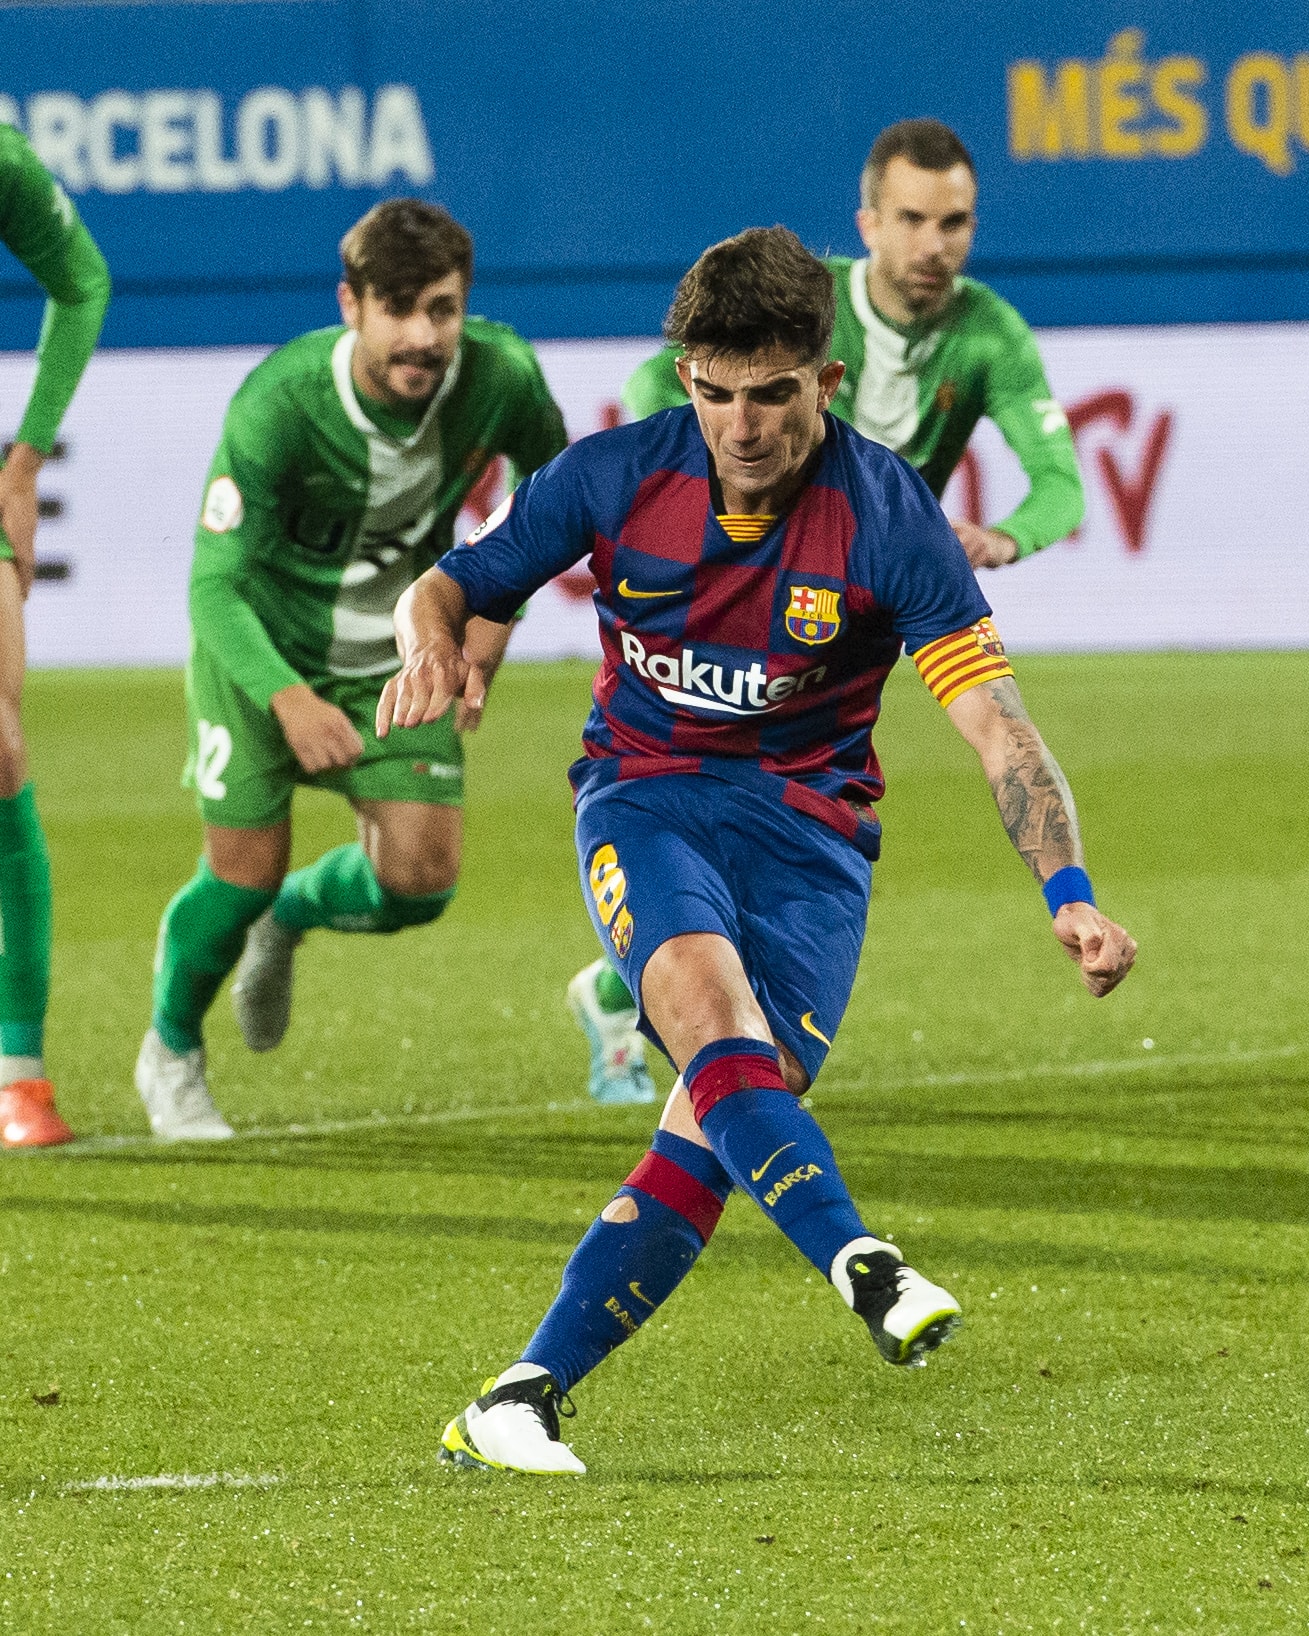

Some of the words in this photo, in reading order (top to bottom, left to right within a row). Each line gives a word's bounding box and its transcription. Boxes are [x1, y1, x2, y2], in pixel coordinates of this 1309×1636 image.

[1008, 26, 1207, 160] MÉS
[0, 84, 436, 193] RCELONA
[620, 630, 828, 707] Rakuten
[589, 843, 627, 927] 8
[763, 1162, 824, 1207] BARÇA
